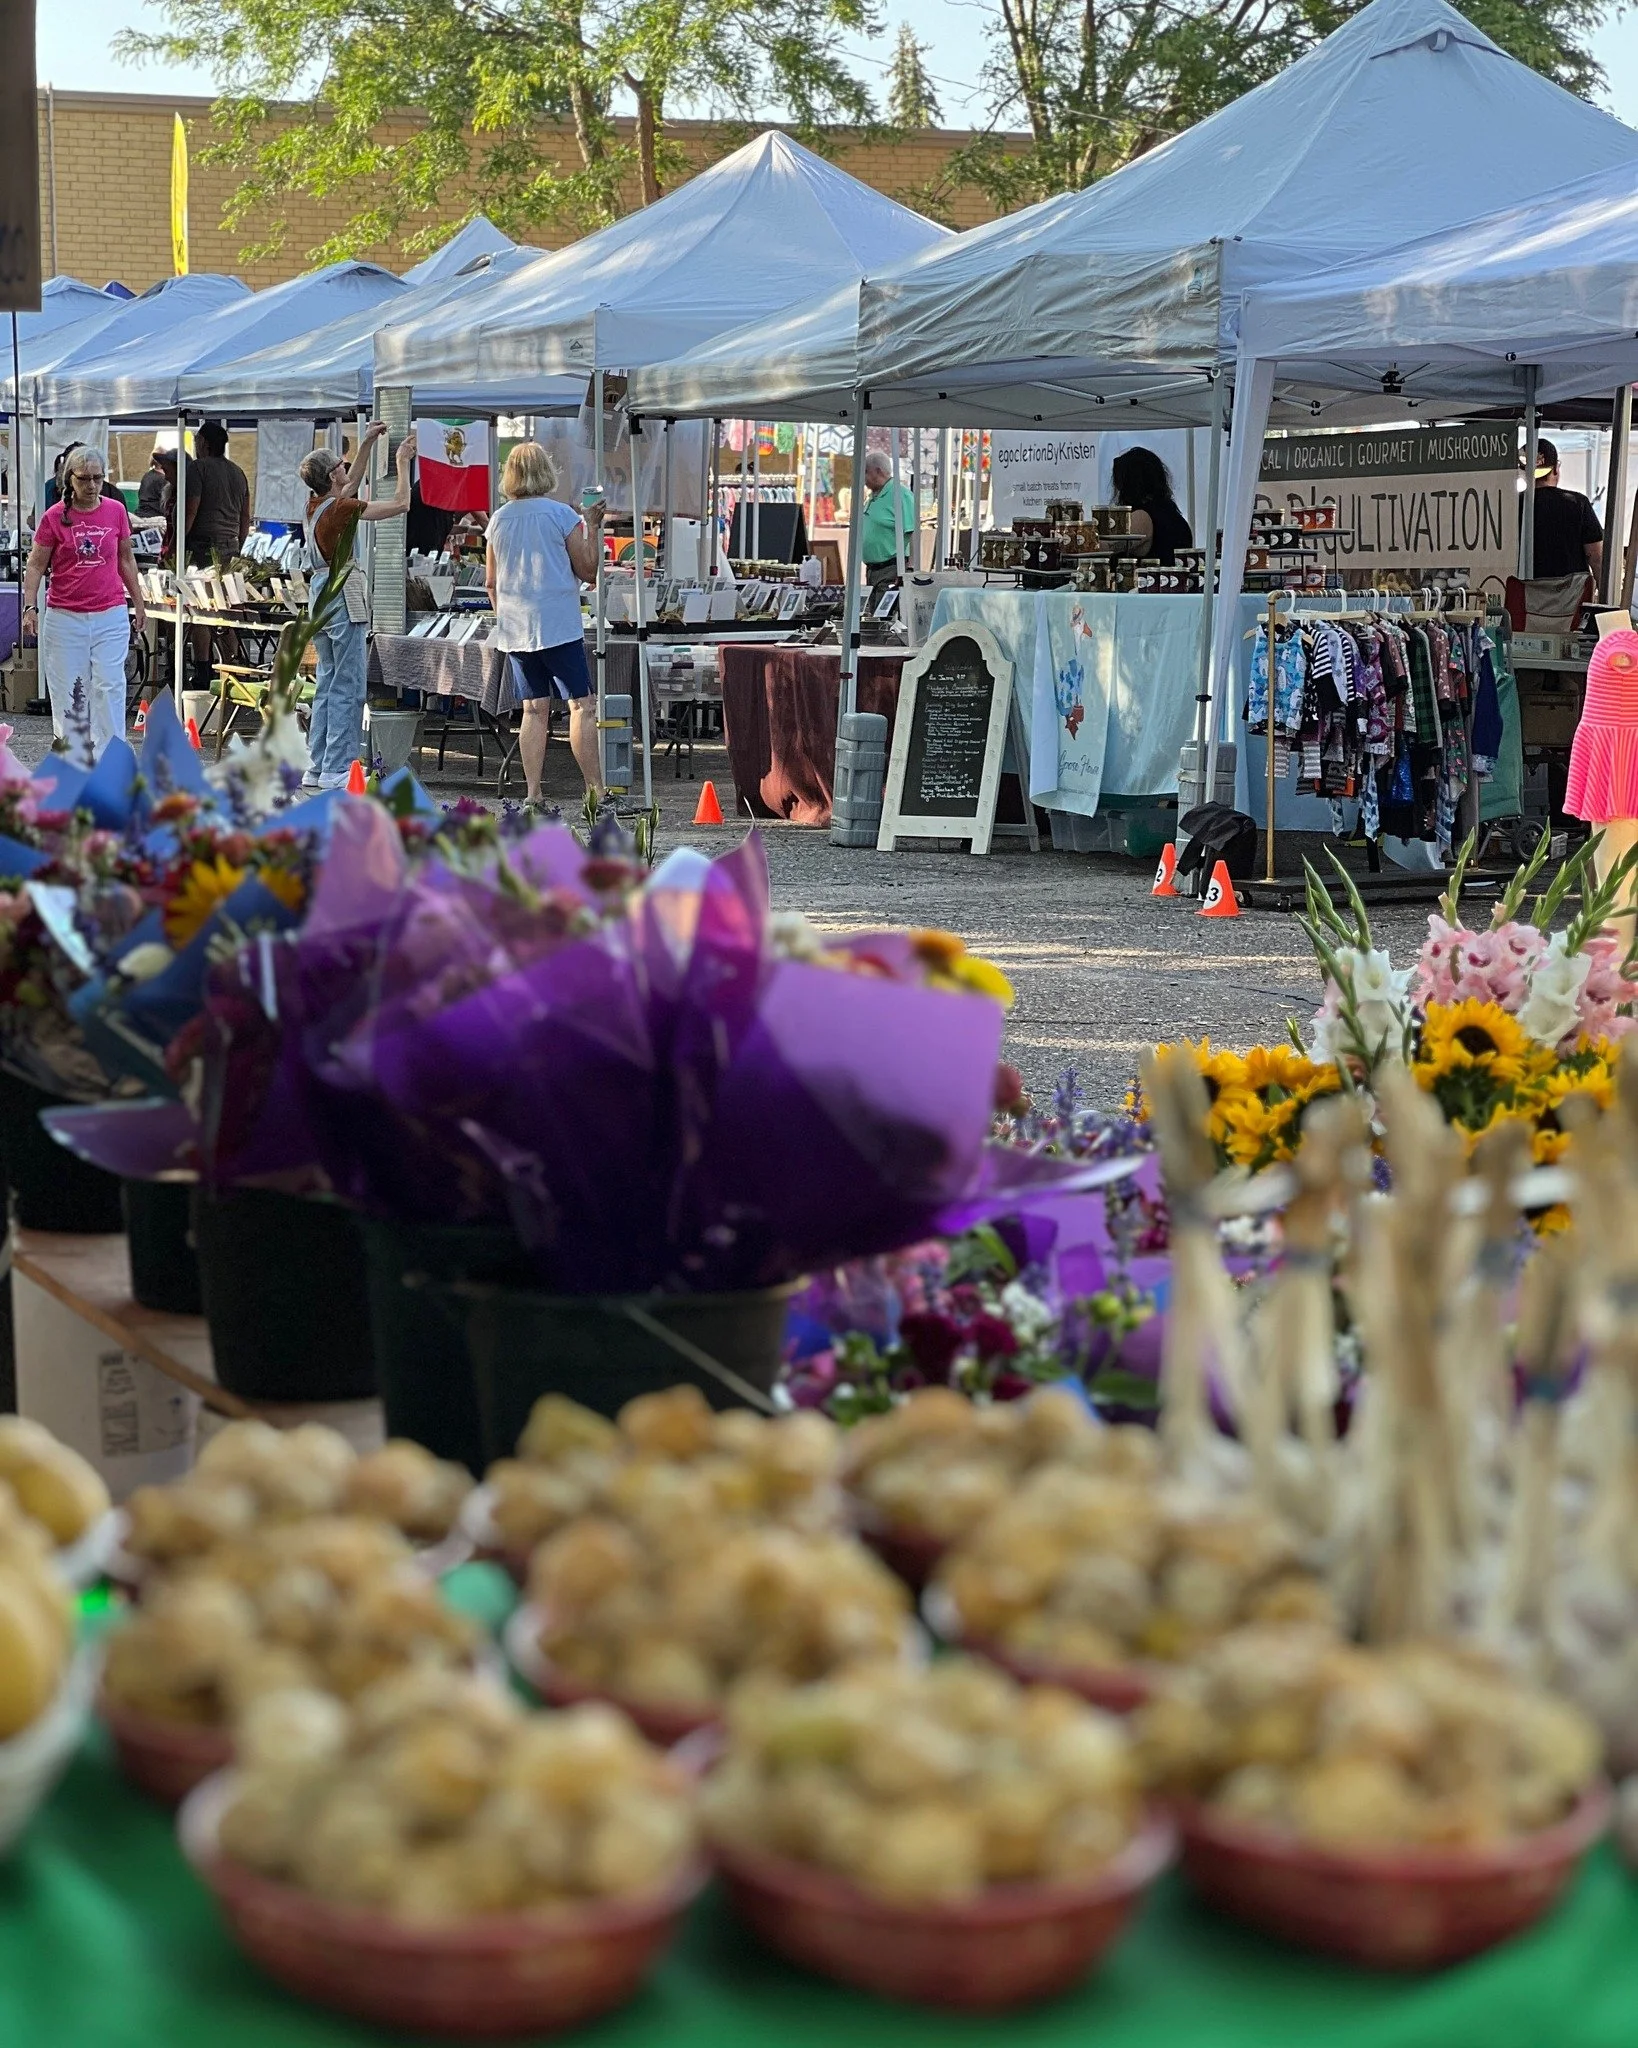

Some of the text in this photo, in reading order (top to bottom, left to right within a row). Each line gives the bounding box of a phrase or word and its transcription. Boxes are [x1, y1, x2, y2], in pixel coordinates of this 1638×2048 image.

[1261, 433, 1508, 470] CAL ORGANIC GOURMET MUSHROOMS
[138, 714, 144, 722] 8
[1156, 868, 1163, 882] 2
[1208, 887, 1219, 901] 3
